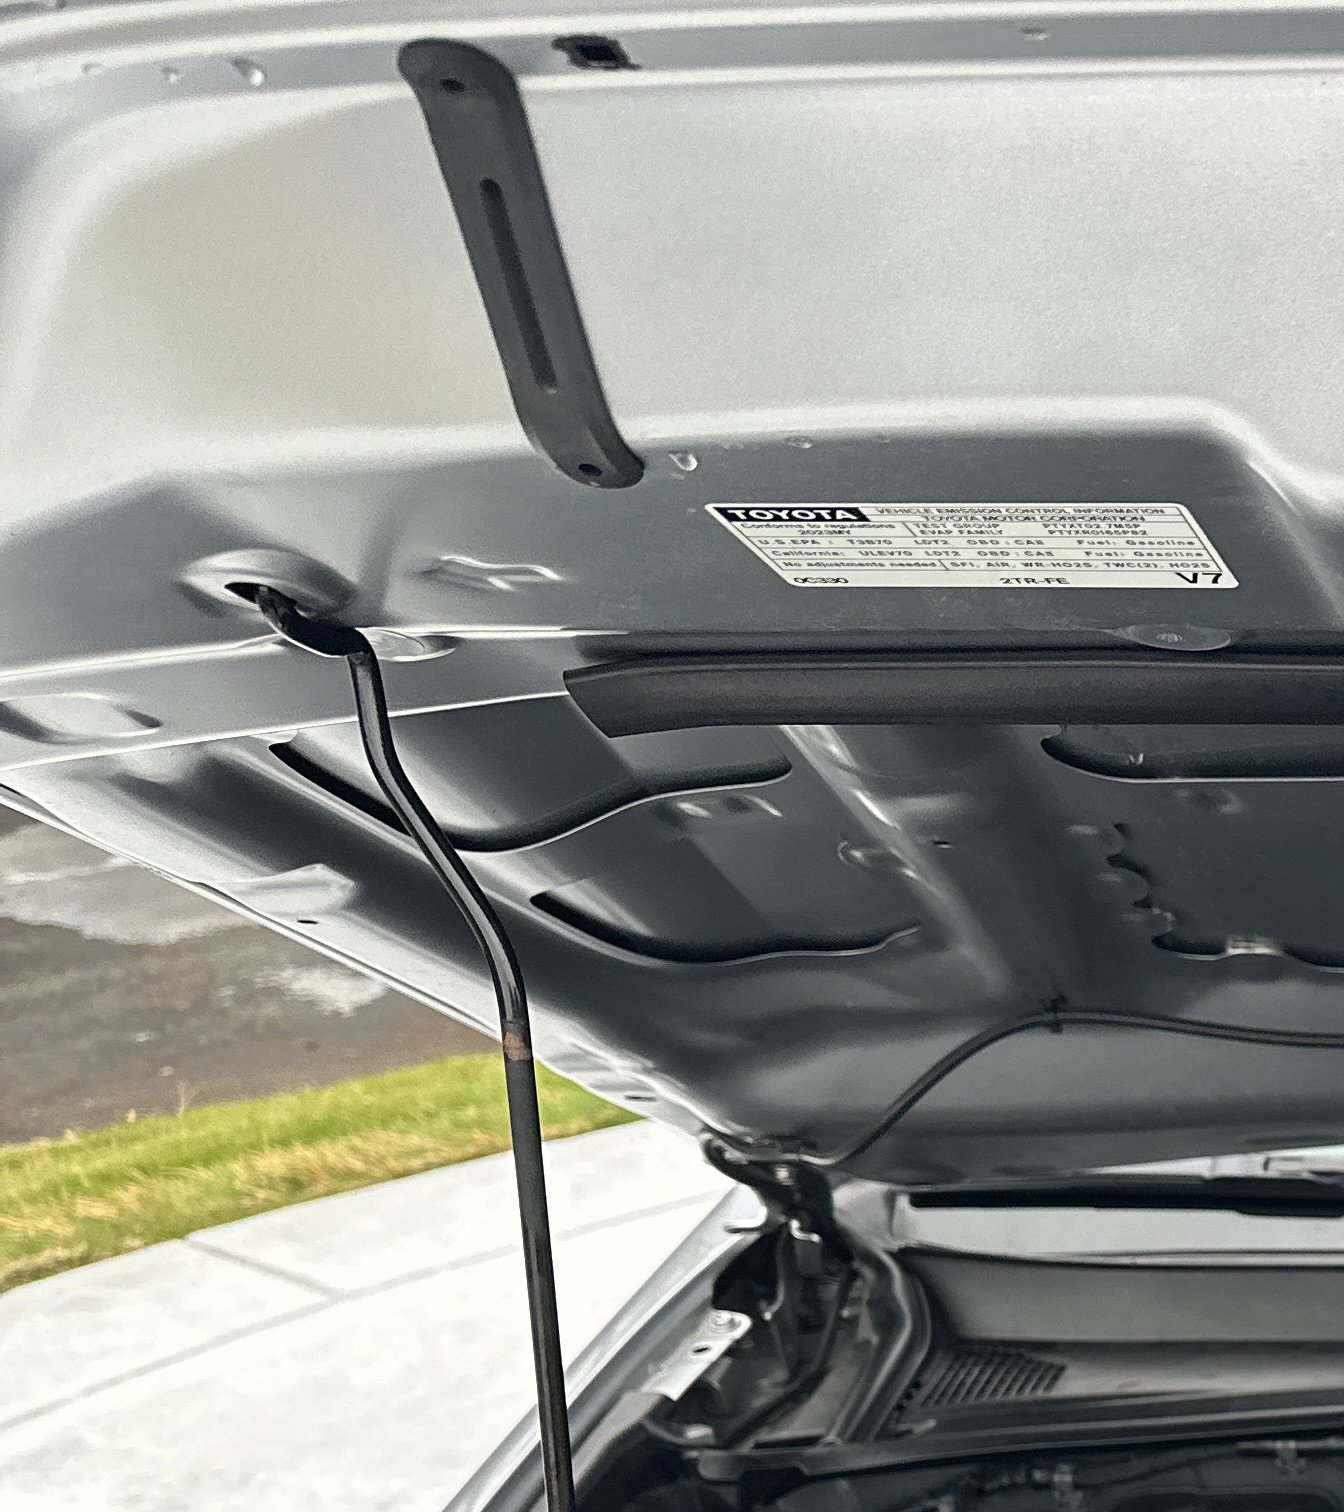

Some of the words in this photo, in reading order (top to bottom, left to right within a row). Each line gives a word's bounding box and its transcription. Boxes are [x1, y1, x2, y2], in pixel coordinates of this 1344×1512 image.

[727, 509, 859, 520] TOYOTA
[999, 577, 1071, 585] 2TR-FE
[1174, 572, 1223, 585] V7
